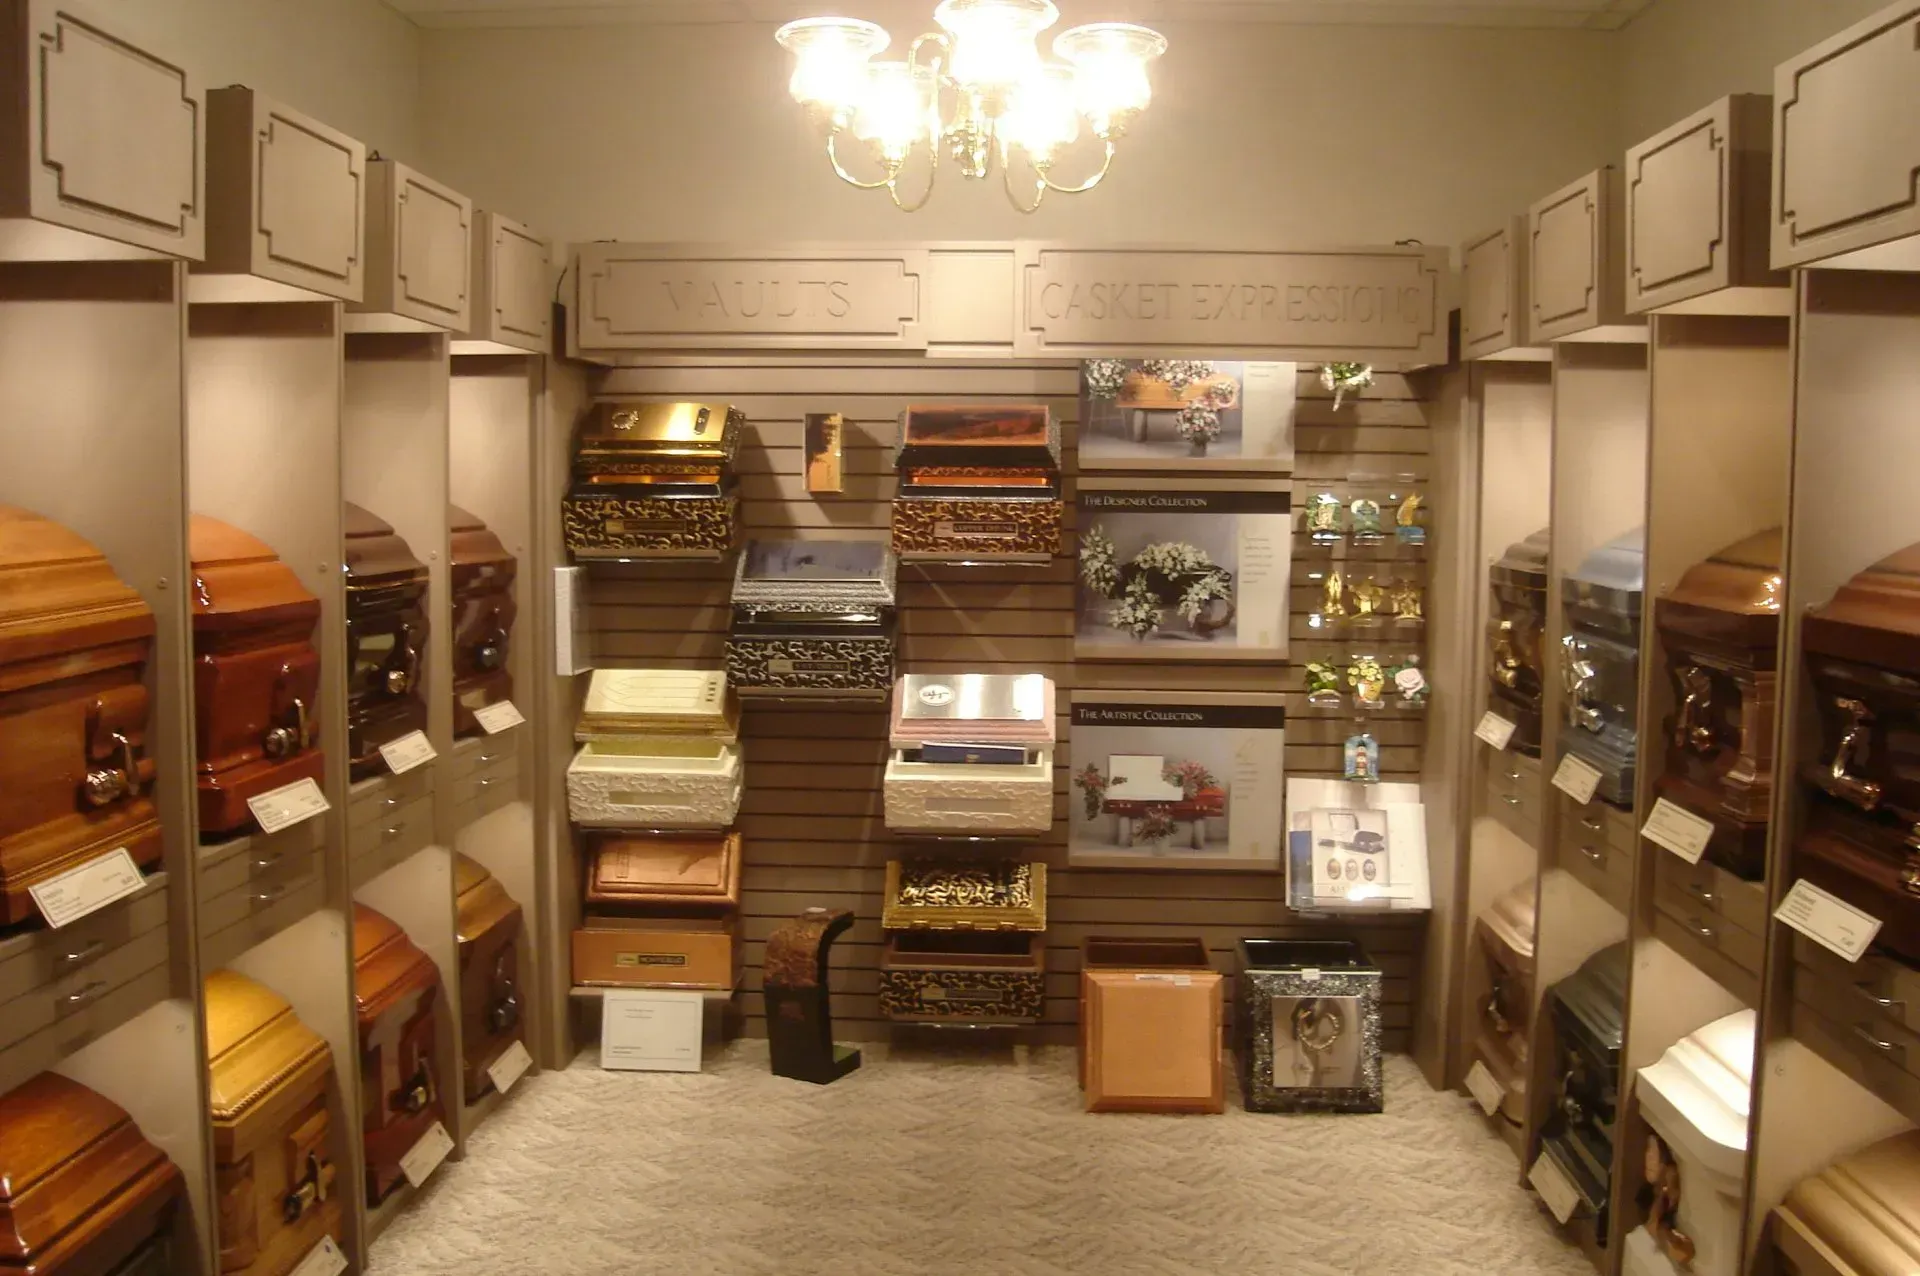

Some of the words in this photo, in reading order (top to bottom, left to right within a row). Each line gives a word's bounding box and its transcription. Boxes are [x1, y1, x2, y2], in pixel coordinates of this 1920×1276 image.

[660, 281, 851, 318] VAULTS
[1040, 281, 1180, 320] CASKET
[1190, 283, 1420, 324] EXPRESSIONS
[1148, 495, 1208, 507] COLLECTION
[1079, 708, 1099, 720] THE
[1101, 709, 1142, 720] ARTISTIC
[1143, 710, 1203, 721] COLLECTION
